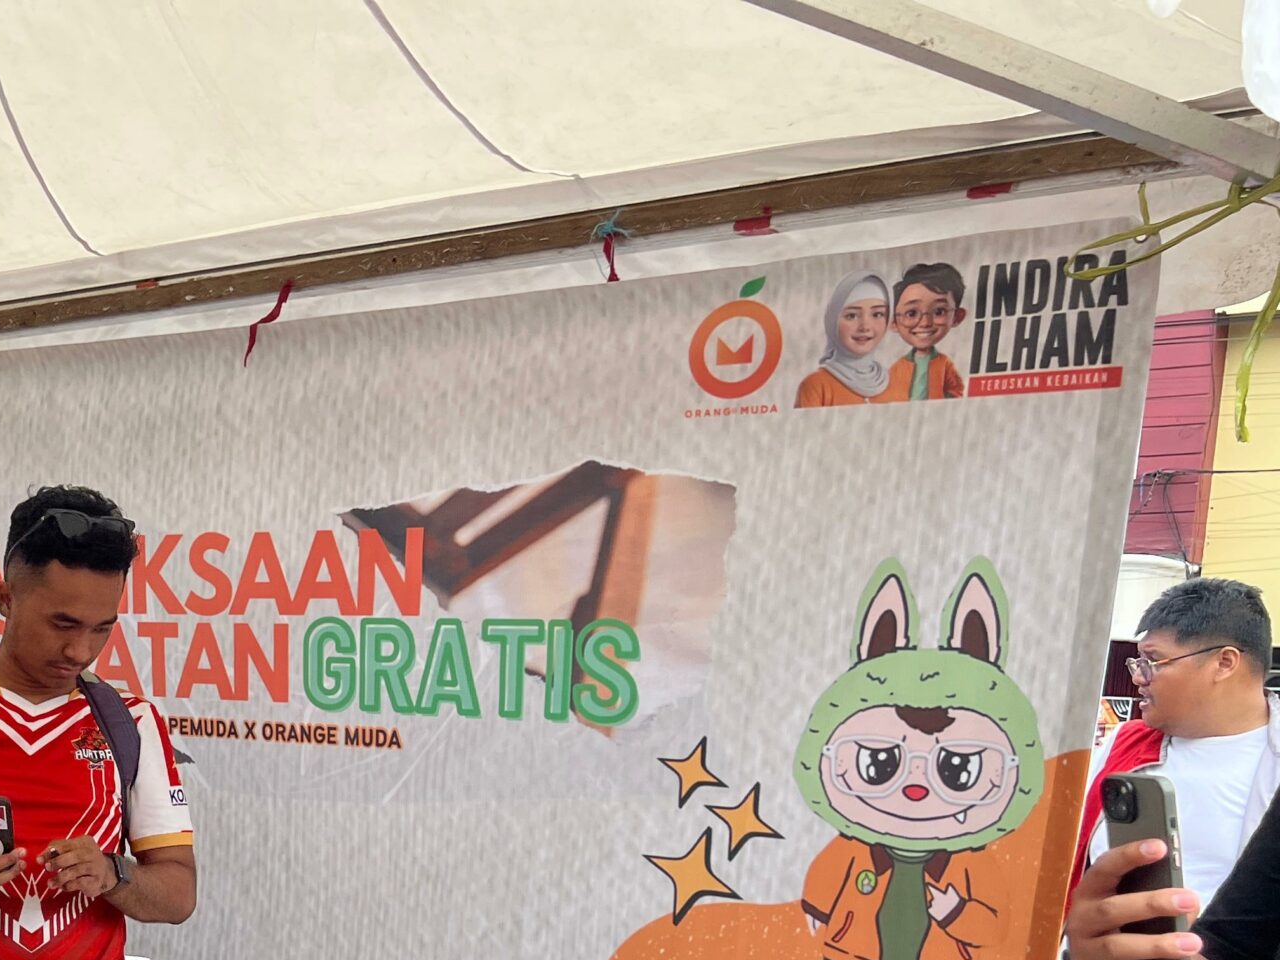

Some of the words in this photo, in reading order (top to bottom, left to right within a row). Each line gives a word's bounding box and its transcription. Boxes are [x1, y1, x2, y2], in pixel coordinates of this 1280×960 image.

[975, 250, 1128, 319] INDIRA
[969, 308, 1117, 374] ILHAM
[980, 377, 1040, 391] TERUSKAN
[1046, 372, 1108, 387] KEBAIKAN
[740, 404, 778, 415] MUDA
[303, 616, 641, 725] GRATIS
[169, 717, 239, 739] PEMUDA
[245, 722, 256, 740] X
[262, 723, 337, 744] ORANGE
[345, 727, 401, 748] MUDA
